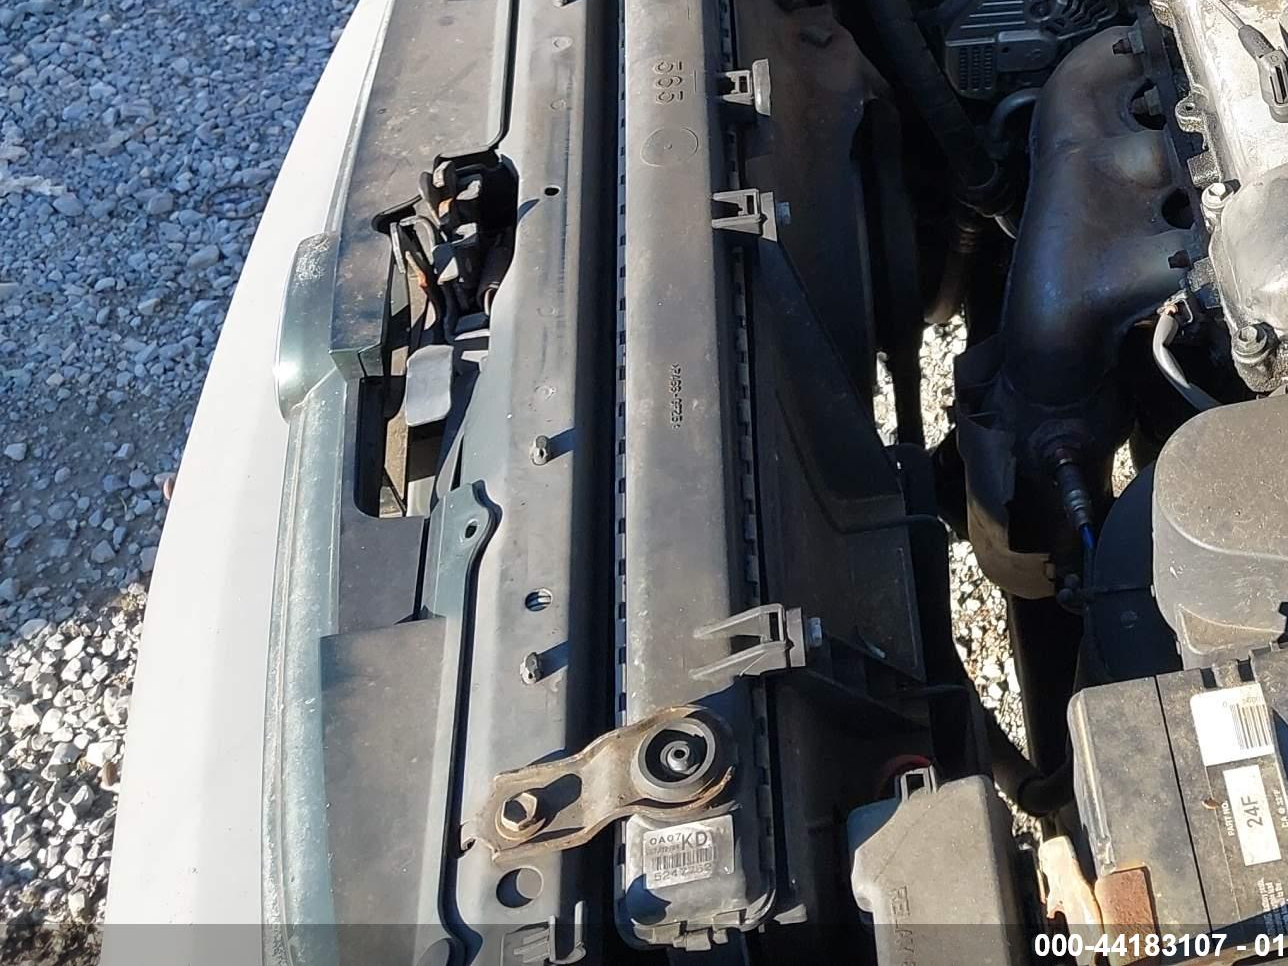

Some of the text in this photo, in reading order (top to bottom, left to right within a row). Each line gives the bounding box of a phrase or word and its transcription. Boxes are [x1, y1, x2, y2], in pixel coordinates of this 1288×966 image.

[1221, 800, 1236, 837] PART NO.
[1241, 795, 1264, 829] 24F
[681, 831, 708, 851] KD
